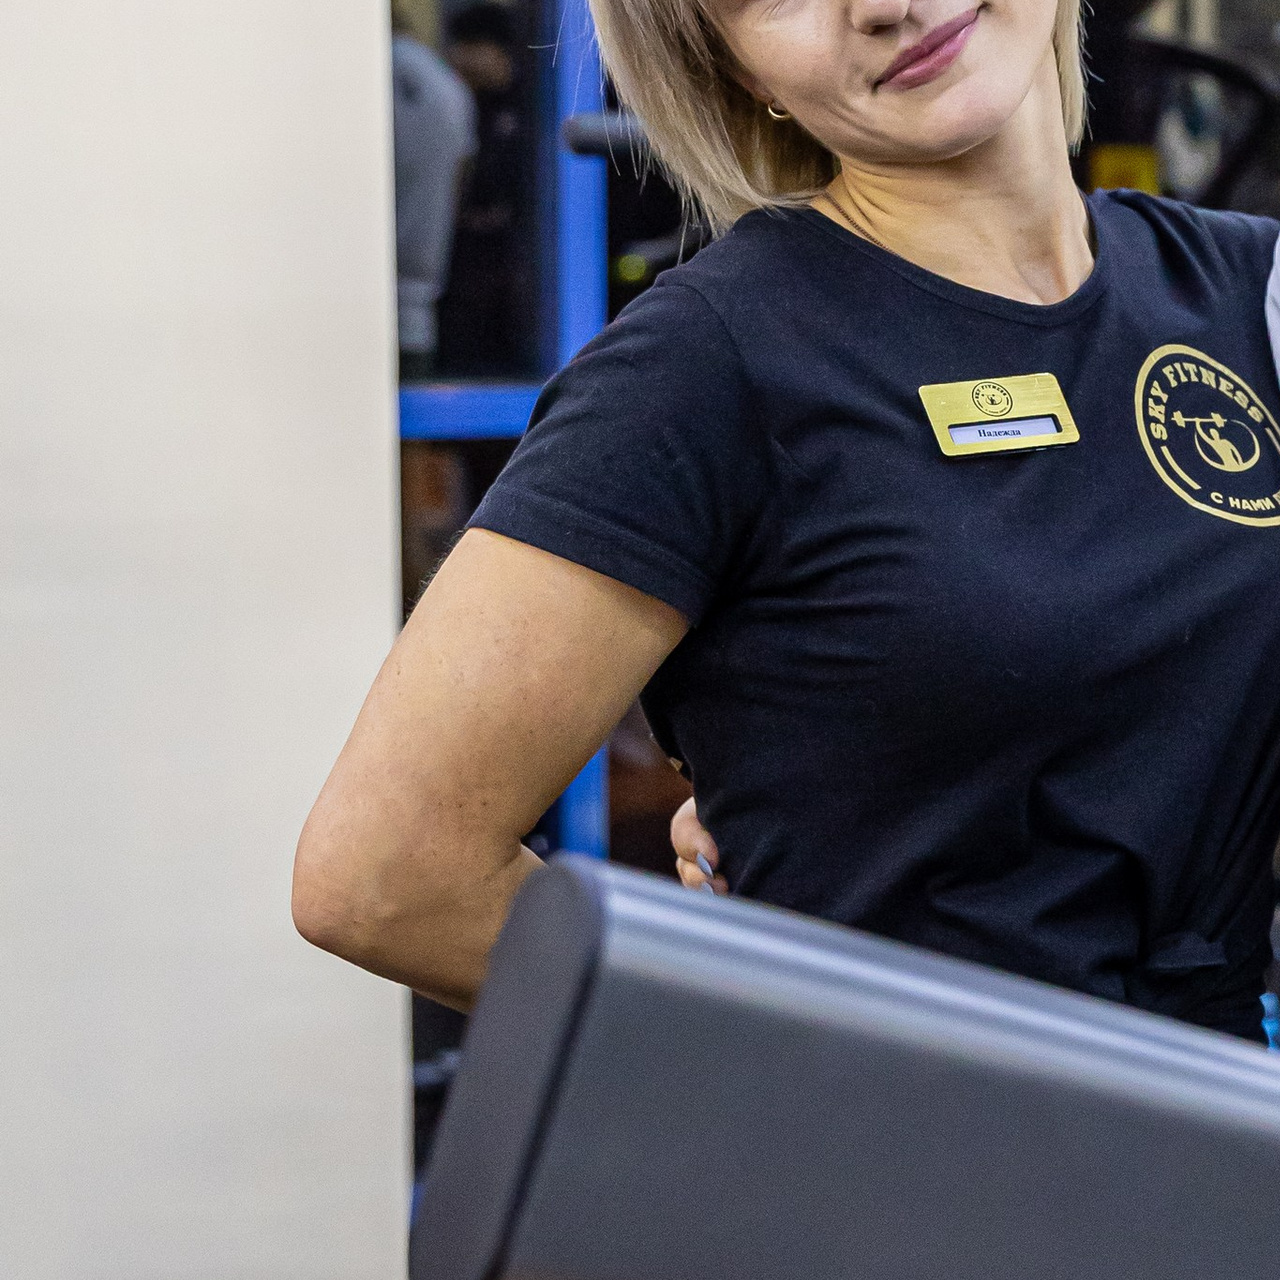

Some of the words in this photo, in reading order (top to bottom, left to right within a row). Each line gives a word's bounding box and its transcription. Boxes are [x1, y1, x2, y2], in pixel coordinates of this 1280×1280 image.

[1148, 380, 1169, 441] SKY
[1162, 362, 1265, 423] FITNESS
[978, 429, 1022, 438] Надежда
[1228, 496, 1276, 511] НАМИ
